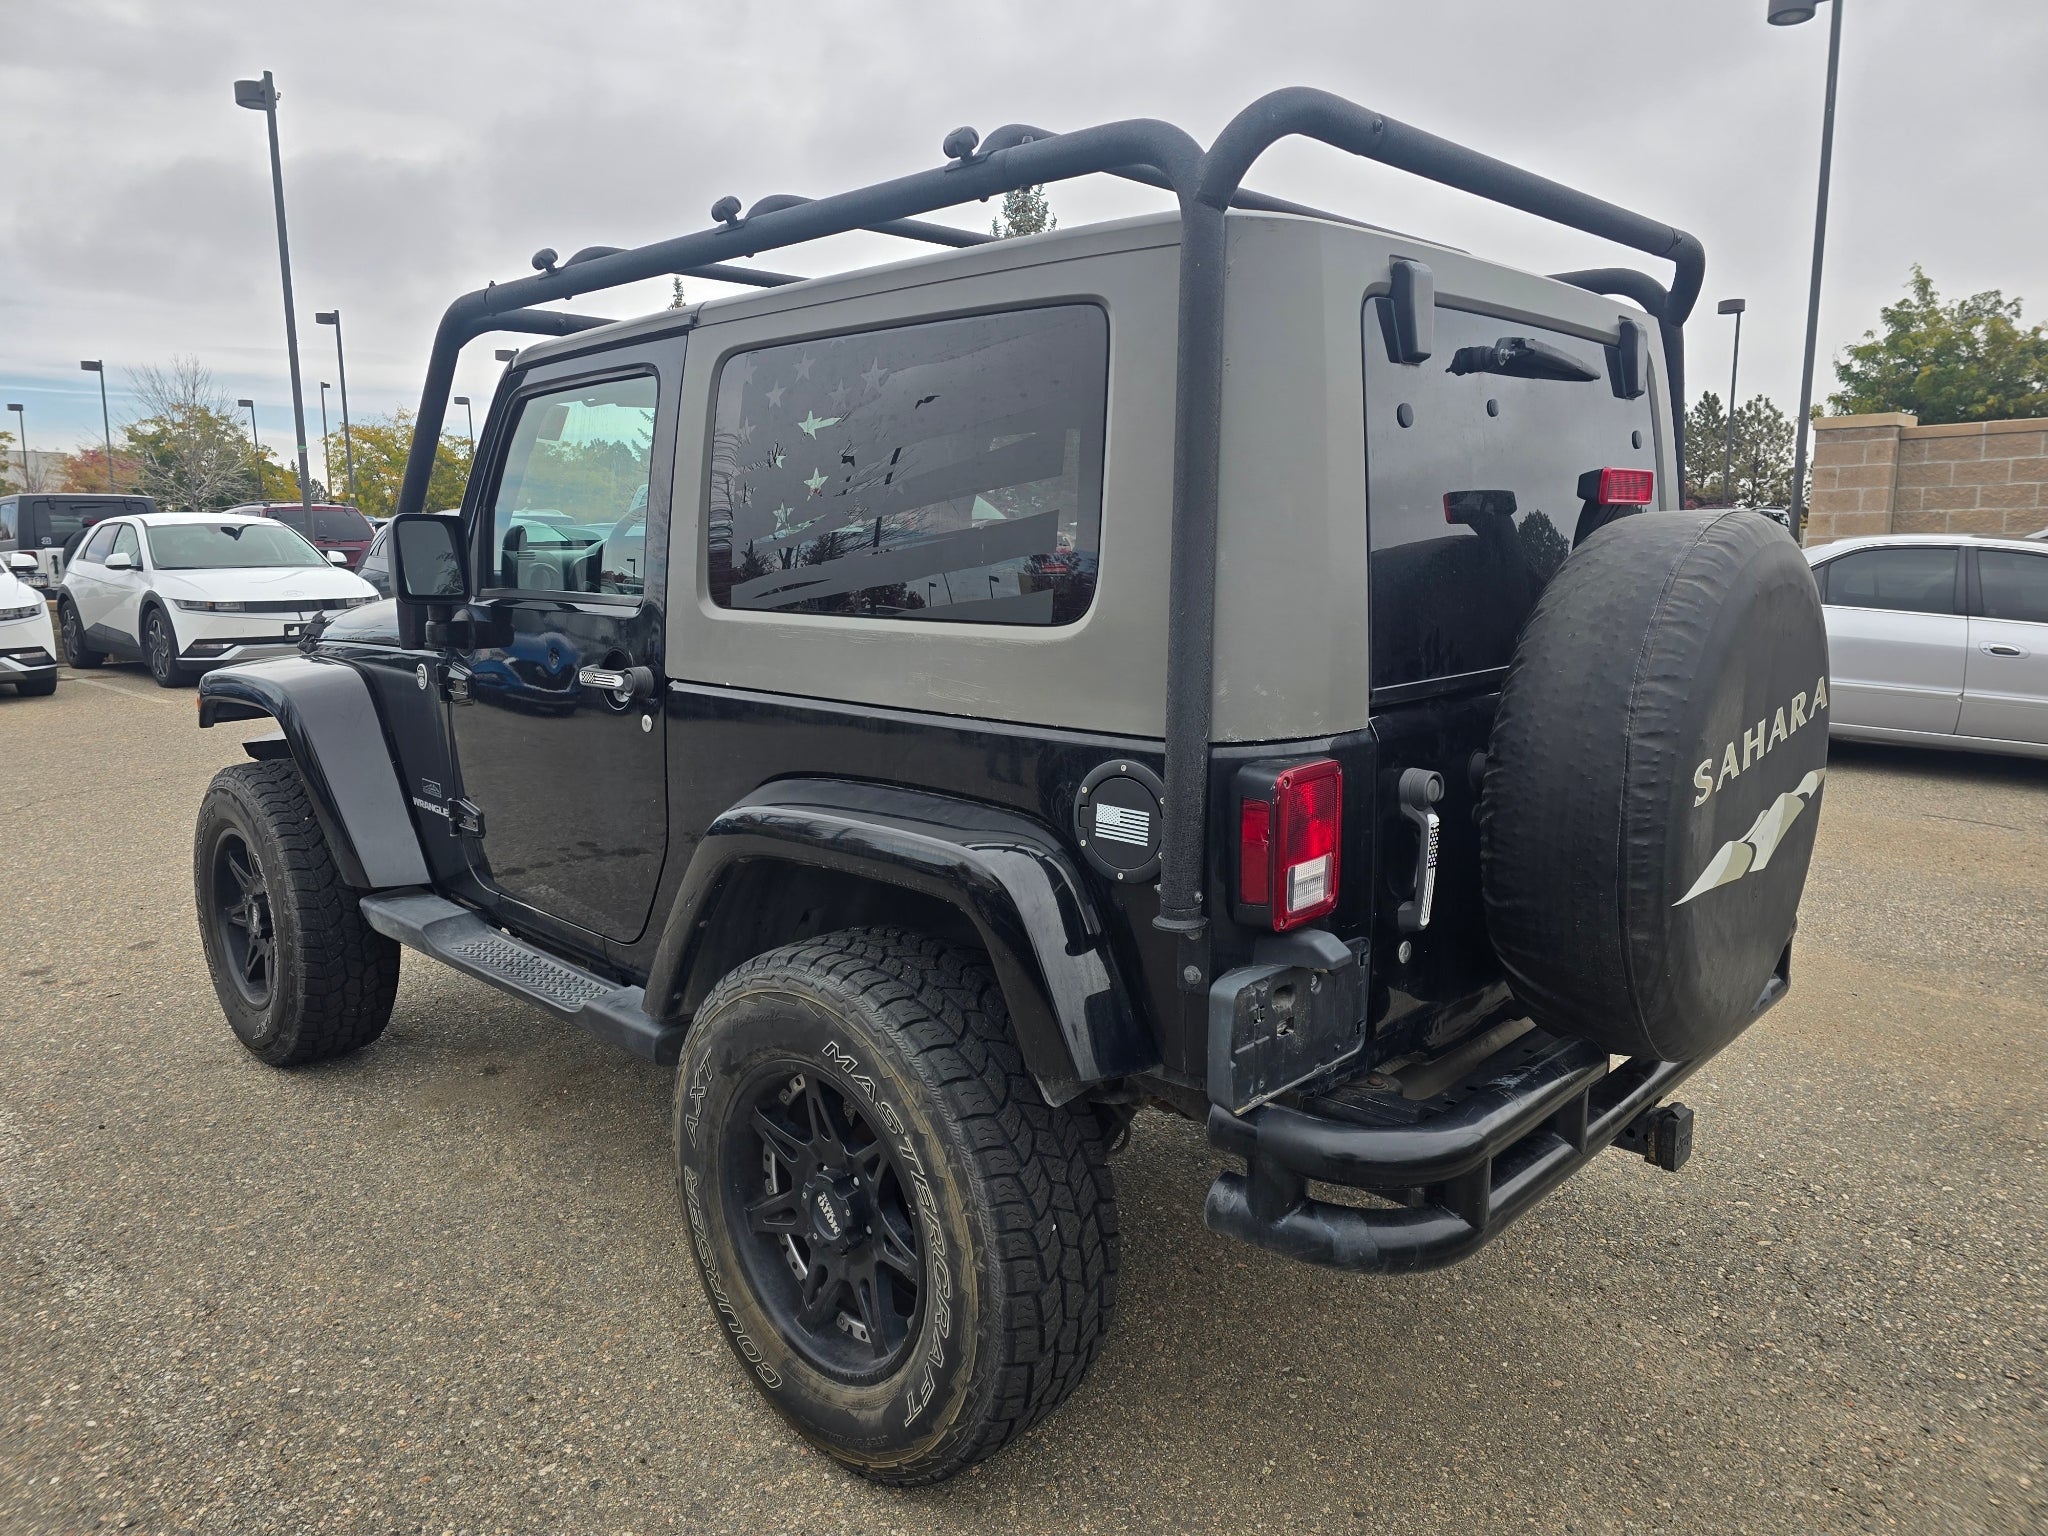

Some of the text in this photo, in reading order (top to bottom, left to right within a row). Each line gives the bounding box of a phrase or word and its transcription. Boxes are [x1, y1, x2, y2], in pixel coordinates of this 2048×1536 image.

[412, 796, 450, 818] WRANGLE
[1692, 675, 1829, 808] SAHARA
[684, 1165, 784, 1389] COURSER
[821, 1041, 952, 1428] MASTERCRAFT
